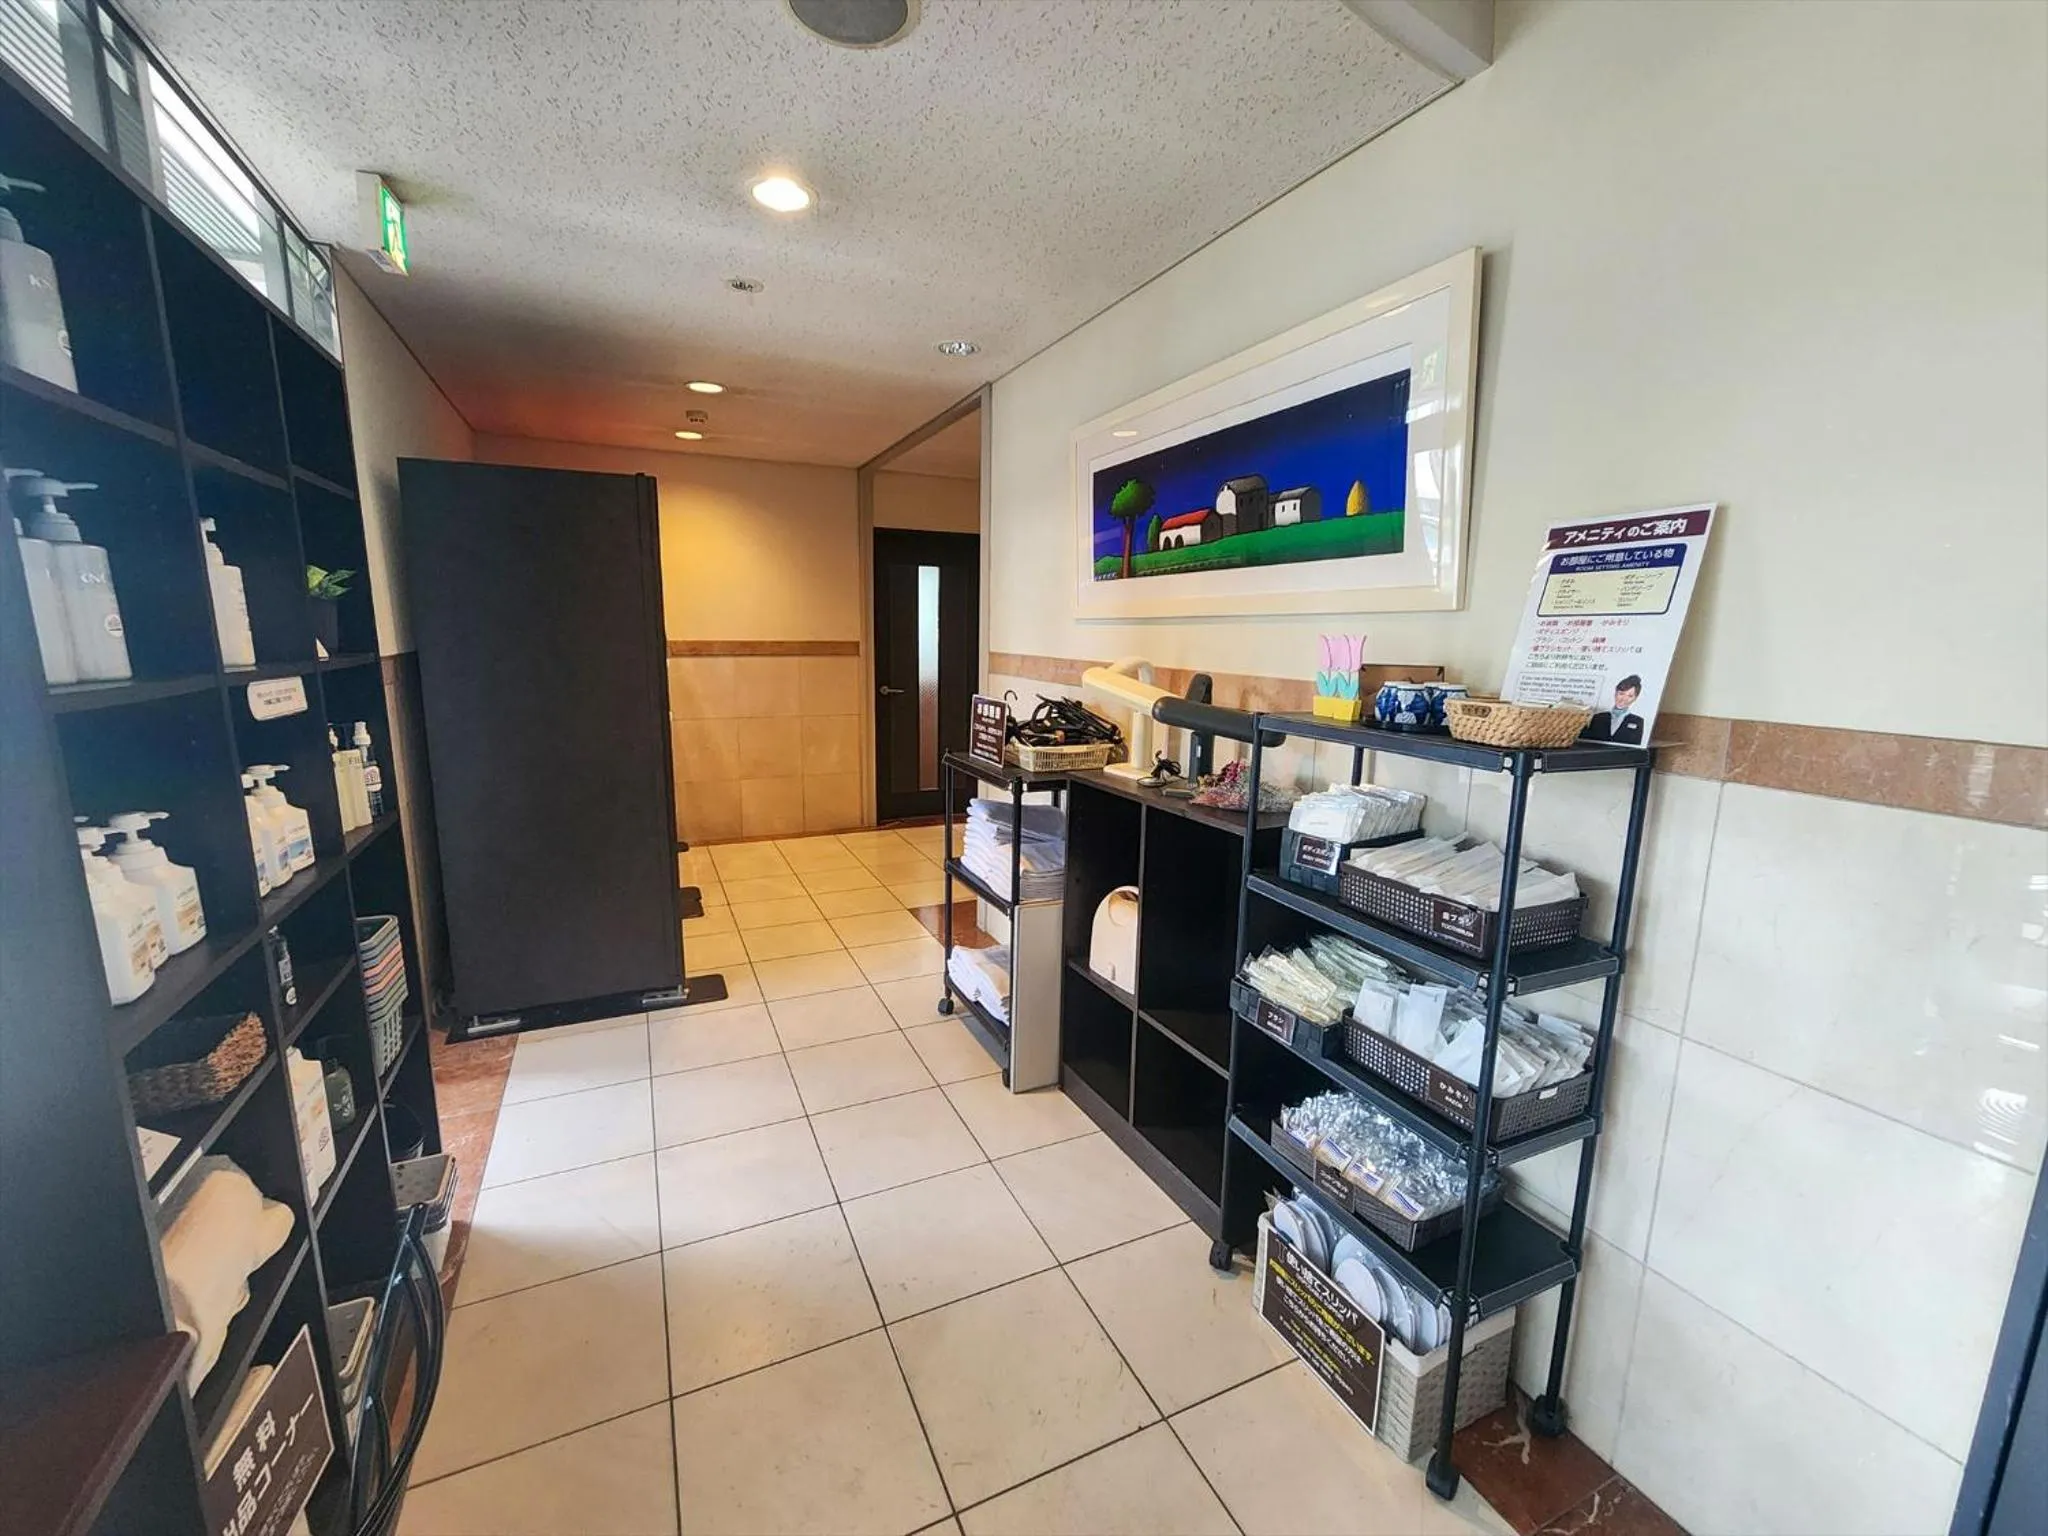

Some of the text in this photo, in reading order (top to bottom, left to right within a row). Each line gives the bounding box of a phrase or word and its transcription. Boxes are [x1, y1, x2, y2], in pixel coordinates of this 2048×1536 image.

[1563, 518, 1688, 545] アメニティのご案内
[1440, 1081, 1469, 1103] かみそり
[1286, 1251, 1358, 1326] 使い捨てスリッパ
